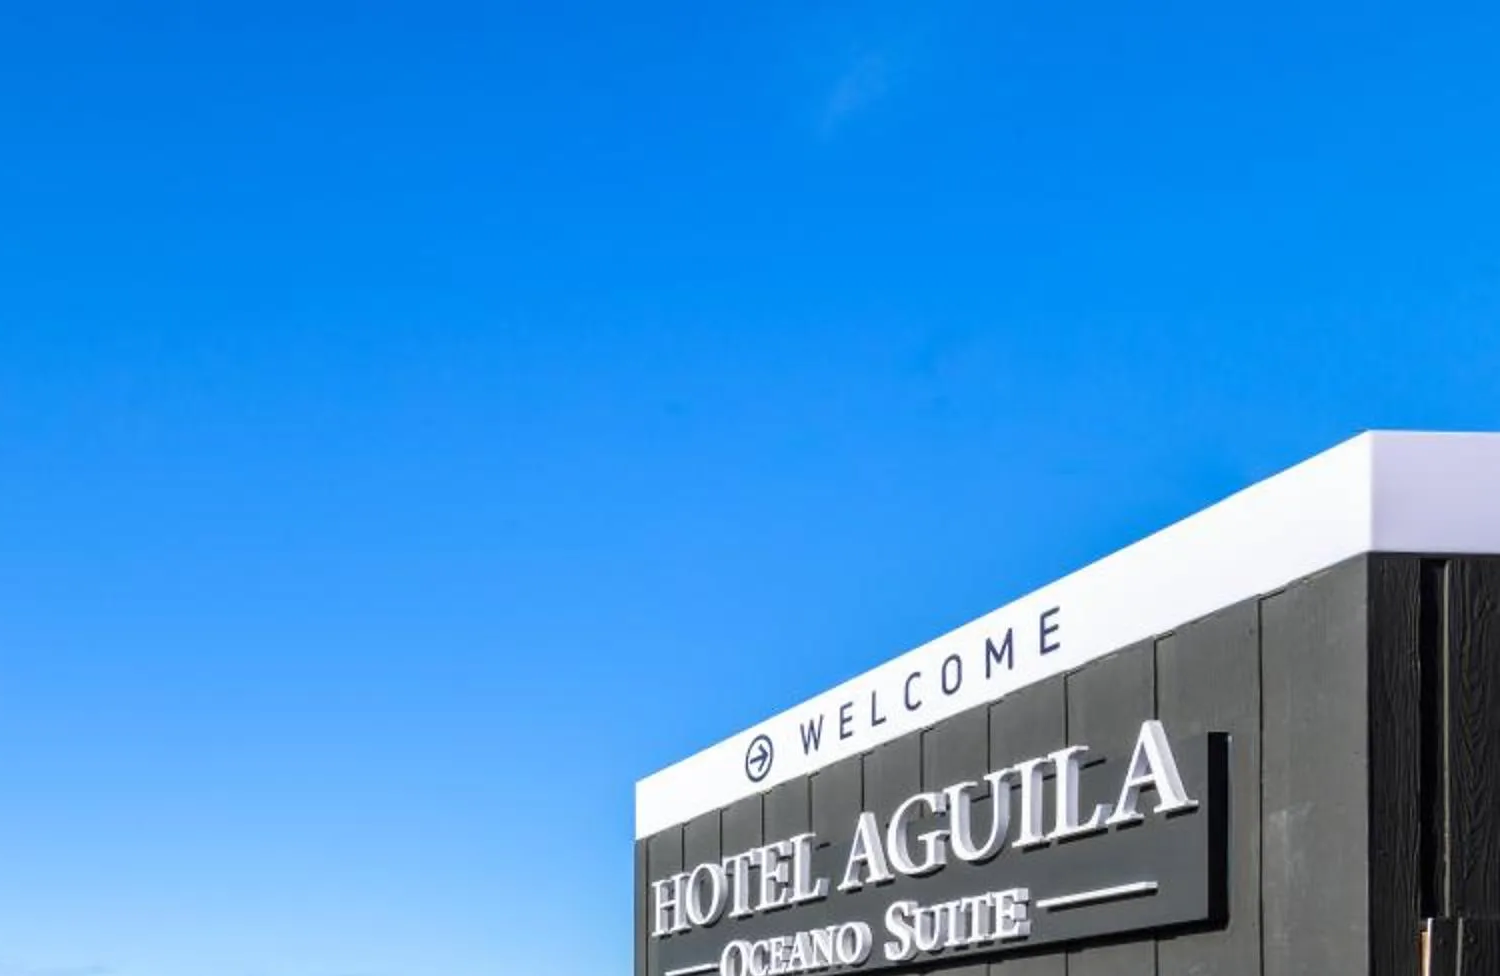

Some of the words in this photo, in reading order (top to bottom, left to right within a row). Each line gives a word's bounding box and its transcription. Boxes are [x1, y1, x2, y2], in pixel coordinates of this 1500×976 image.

[799, 606, 1061, 755] WELCOME
[652, 832, 829, 936] HOTEL
[837, 720, 1199, 890] AGUILA
